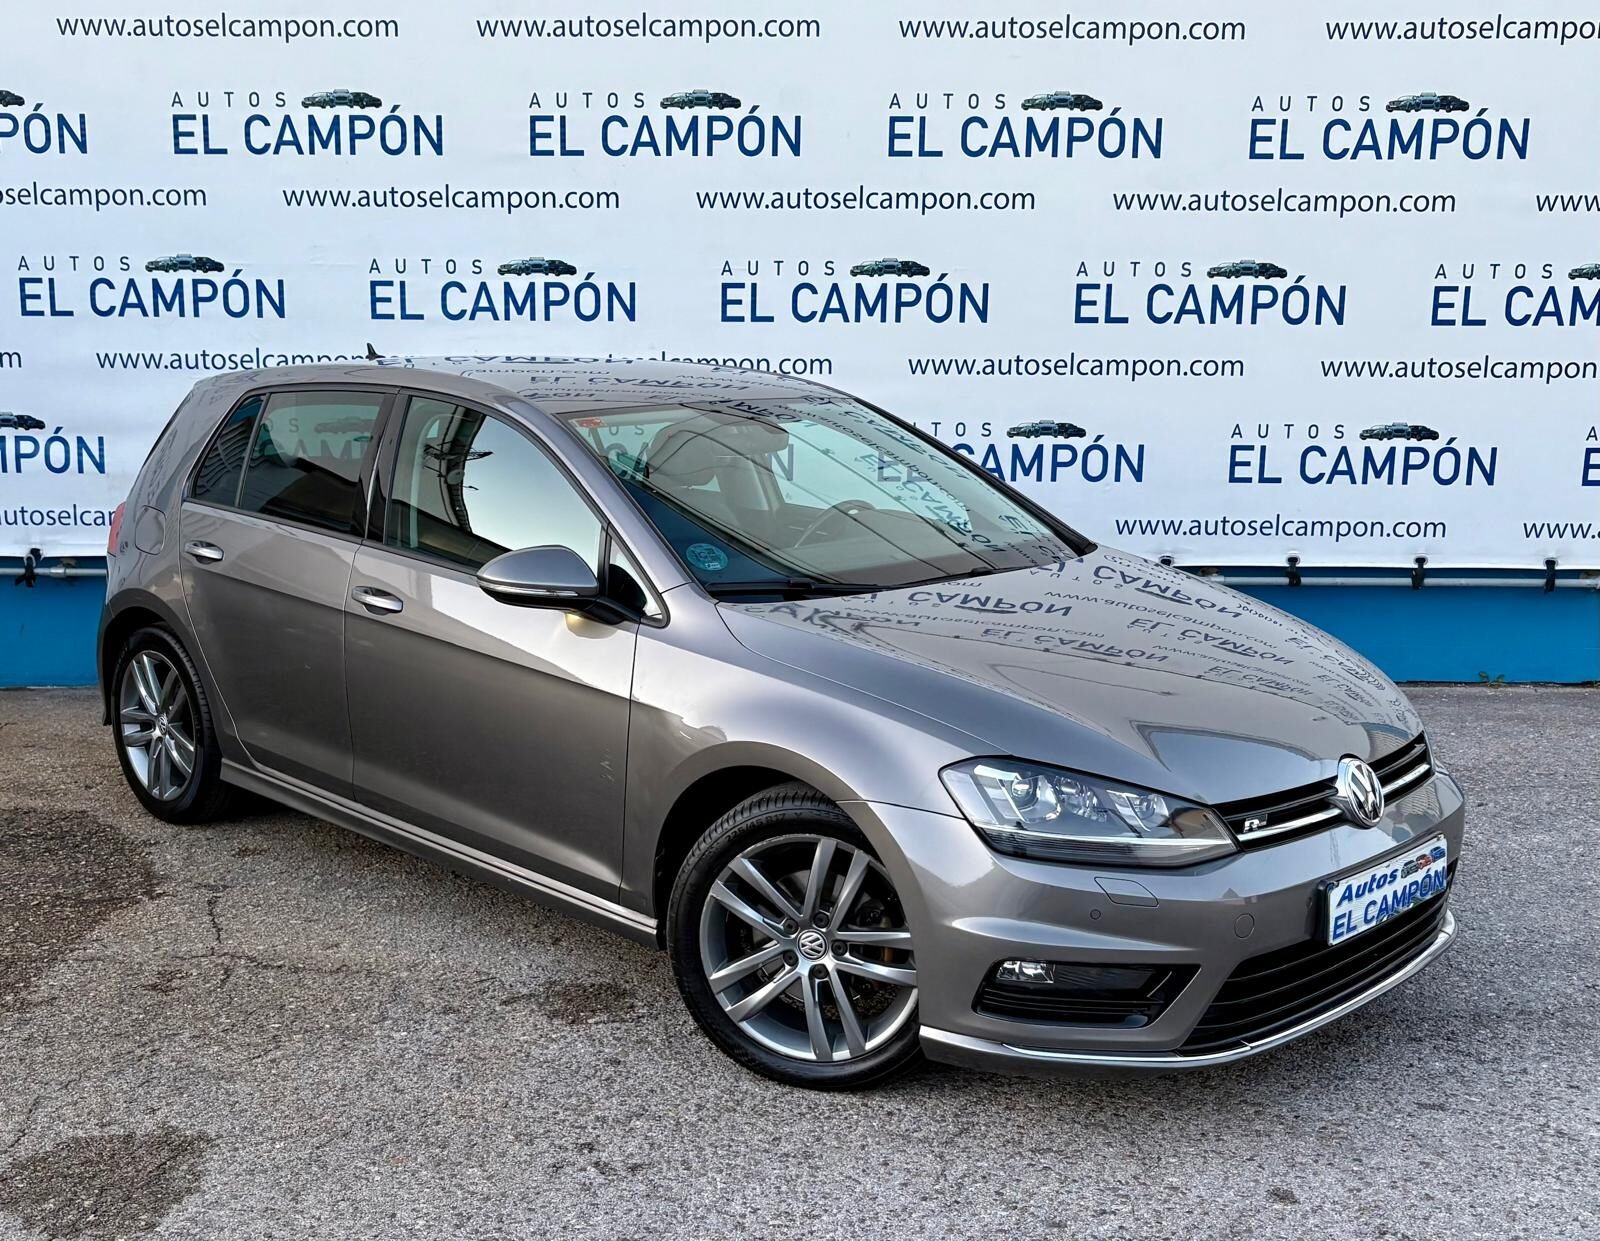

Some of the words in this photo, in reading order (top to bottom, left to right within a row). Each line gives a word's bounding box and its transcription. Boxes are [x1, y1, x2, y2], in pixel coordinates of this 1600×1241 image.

[55, 11, 399, 44] www.autoselcampon.com
[476, 11, 821, 44] www.autoselcampon.com
[898, 13, 1246, 47] www.autoselcampon.com
[1325, 13, 1600, 46] www.autoselcampo
[170, 91, 287, 108] AUTOS
[528, 91, 645, 109] AUTOS
[888, 92, 1006, 110] AUTOS
[1251, 95, 1371, 113] AUTOS
[170, 114, 228, 156] EL
[243, 104, 444, 157] CAMPÓN
[529, 114, 585, 157] EL
[601, 105, 802, 158] CAMPÓN
[887, 115, 944, 158] EL
[960, 107, 1163, 160] CAMPÓN
[1248, 118, 1305, 161] EL
[1322, 108, 1531, 161] CAMPÓN
[0, 180, 207, 212] selcampon.com
[282, 183, 620, 215] www.autoselcampon.com
[695, 184, 1036, 216] www.autoselcampon.com
[1112, 187, 1456, 219] www.autoselcampon.com
[17, 255, 131, 272] AUTOS
[368, 257, 483, 275] AUTOS
[720, 259, 835, 277] AUTOS
[1075, 260, 1192, 278] AUTOS
[1434, 263, 1553, 280] AUTOS
[18, 277, 75, 318] EL
[89, 269, 286, 319] CAMPÓN
[369, 280, 425, 321] EL
[440, 272, 637, 323] CAMPÓN
[720, 282, 775, 323] EL
[791, 273, 990, 324] CAMPÓN
[1073, 283, 1130, 325] EL
[1146, 275, 1347, 326] CAMPÓN
[1430, 285, 1487, 327] EL
[907, 351, 1244, 383] www.autoselcampon.com
[1320, 354, 1599, 385] www.autoselcampon
[1230, 423, 1345, 440] AUTOS
[0, 426, 106, 475] PÓN
[1227, 444, 1283, 485] EL
[1299, 437, 1498, 487] CAMPÓN
[0, 503, 113, 527] utoselca
[1114, 513, 1447, 543] www.autoselcampon.com
[1522, 522, 1600, 540] www.
[1336, 868, 1399, 907] Autos
[1332, 910, 1358, 942] EL
[1363, 866, 1446, 926] CAMPÓN
